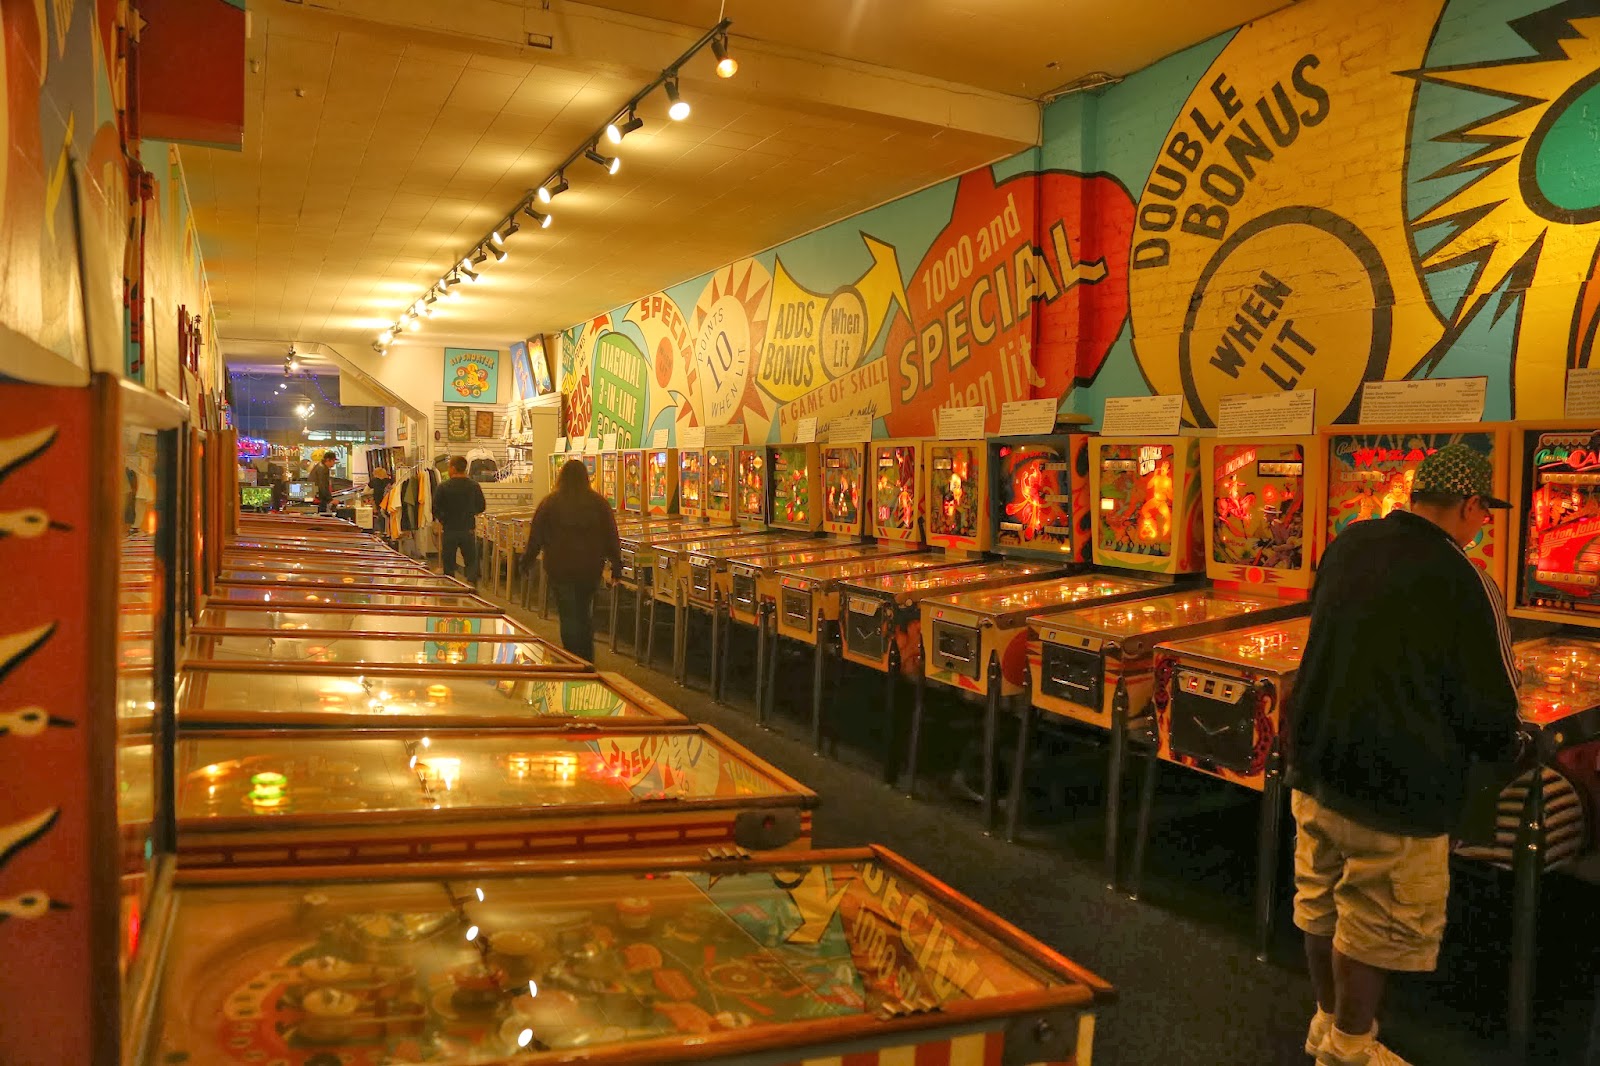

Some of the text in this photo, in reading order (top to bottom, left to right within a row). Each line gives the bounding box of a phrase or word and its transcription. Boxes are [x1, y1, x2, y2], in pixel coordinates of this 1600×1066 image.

[1133, 73, 1243, 270] DOUBLE
[1180, 54, 1331, 241] BONUS
[922, 193, 1020, 310] 1000 and
[698, 308, 724, 362] POINTS
[773, 301, 816, 341] ADDS
[831, 308, 860, 335] When
[899, 219, 1108, 405] SPECIAL
[1209, 270, 1293, 379] WHEN
[600, 341, 640, 389] DIAGONAL
[641, 296, 697, 397] SPECIAL
[707, 331, 733, 393] 10
[763, 343, 816, 388] BONUS
[833, 340, 850, 369] Lit
[999, 335, 1046, 402] lit
[1260, 319, 1317, 391] LIT
[711, 383, 738, 418] WHEN
[736, 348, 746, 376] LIT
[780, 362, 888, 426] A GAME OF SKILL
